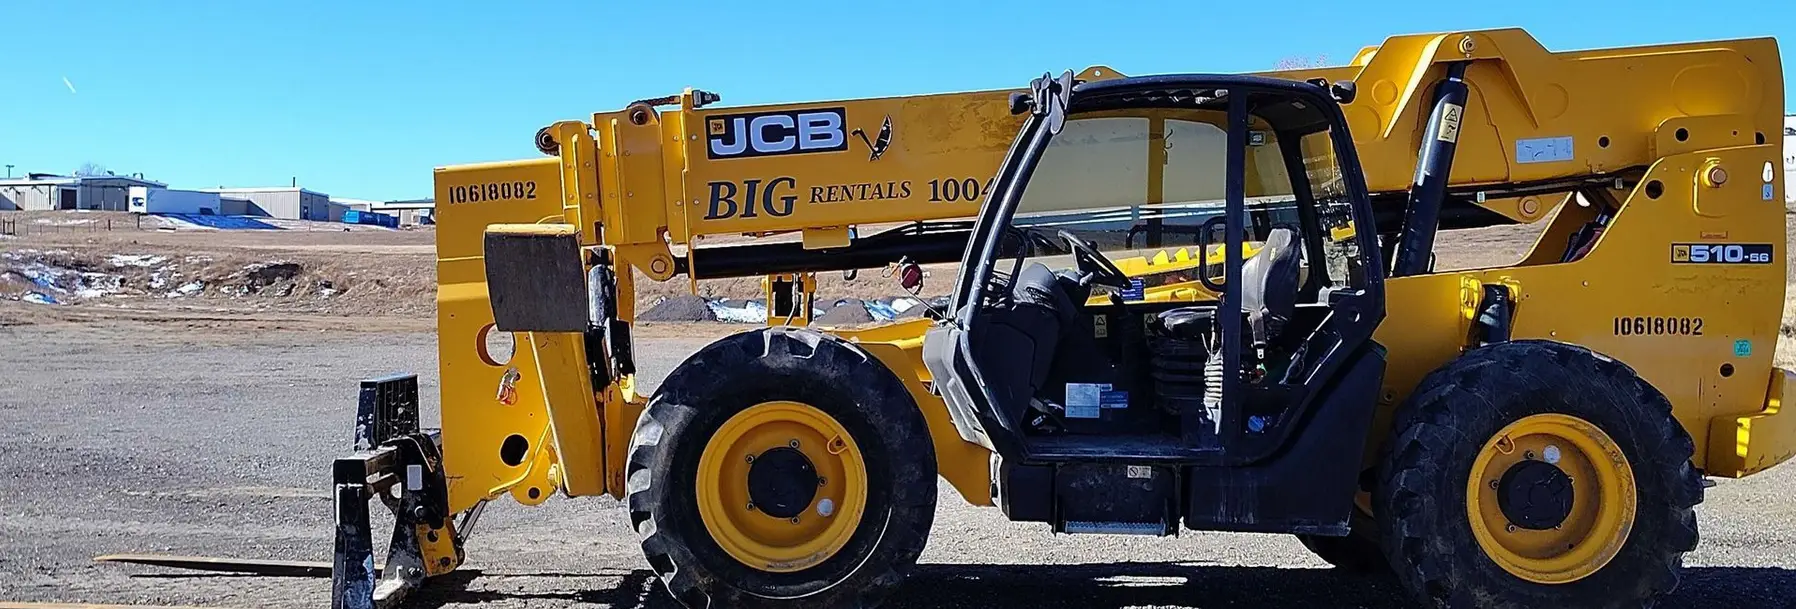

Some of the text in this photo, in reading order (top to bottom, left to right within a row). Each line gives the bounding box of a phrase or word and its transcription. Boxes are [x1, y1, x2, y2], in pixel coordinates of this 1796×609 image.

[711, 111, 844, 155] JCB
[449, 181, 537, 204] 10618082
[704, 176, 798, 220] BIG
[809, 180, 912, 204] RENTALS
[1614, 317, 1704, 336] 10618082
